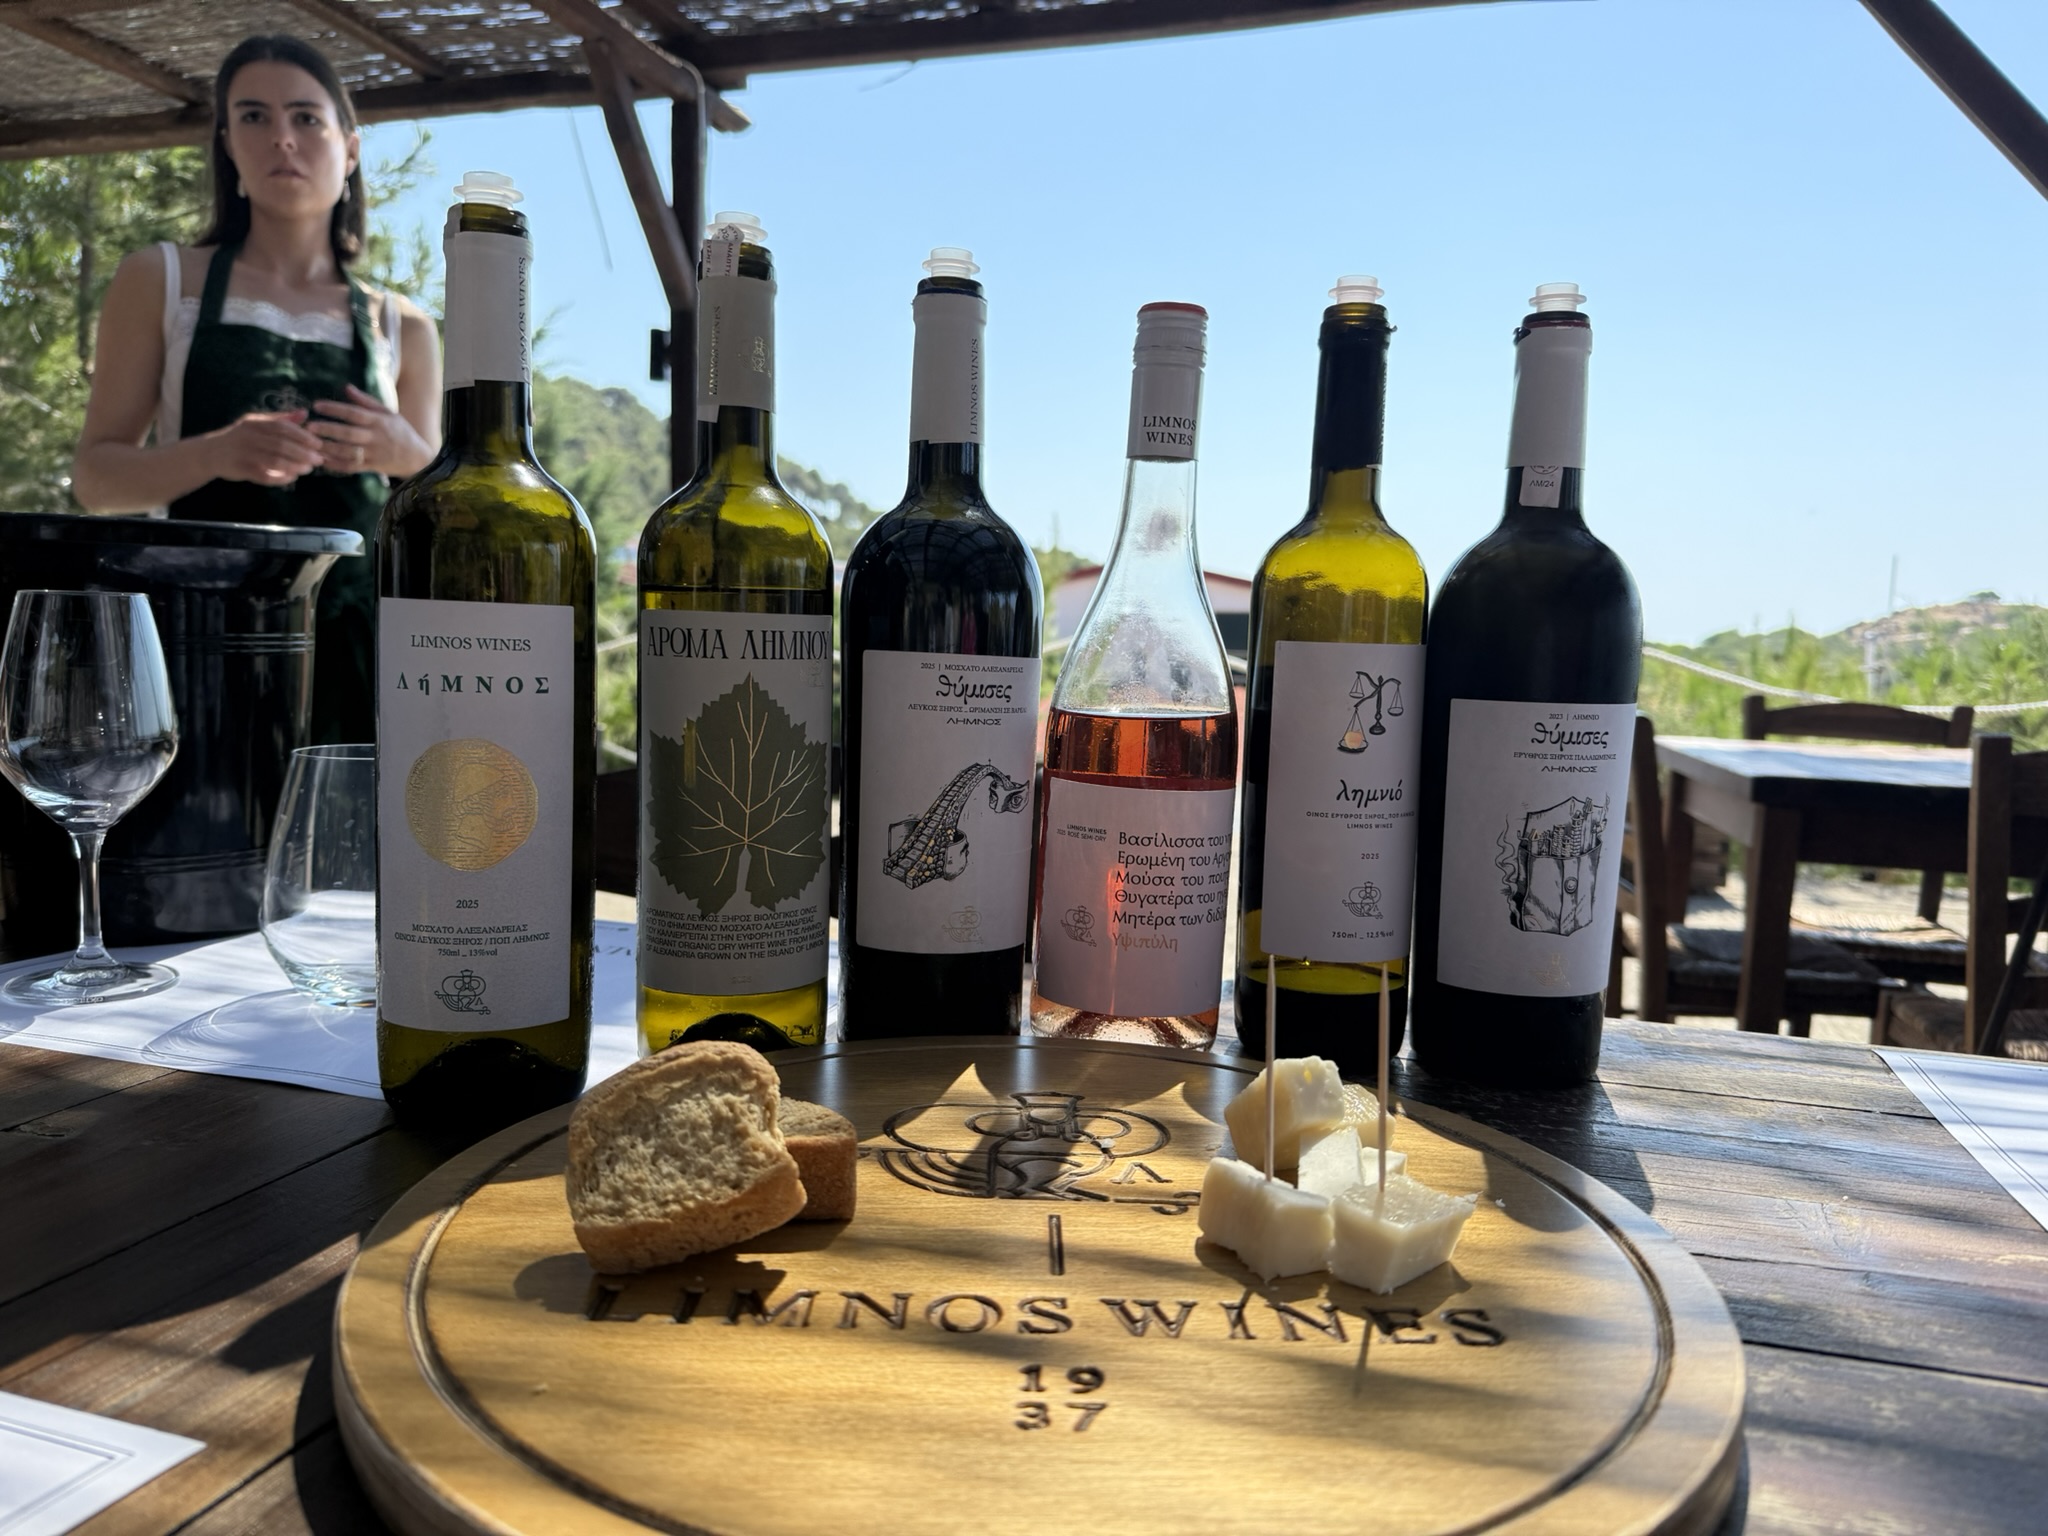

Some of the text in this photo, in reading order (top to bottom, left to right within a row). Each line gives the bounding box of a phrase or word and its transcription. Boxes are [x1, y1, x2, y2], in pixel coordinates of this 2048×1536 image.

[518, 256, 526, 310] WINES
[970, 338, 979, 435] LIMNOS WINES
[1143, 416, 1197, 431] LIMNOS
[1146, 431, 1193, 446] WINES
[411, 635, 531, 651] LIMNOS WINES
[740, 629, 829, 660] ΛΗΜΝΟΥ
[944, 664, 980, 672] ΜΟΣΧΑΤΟ
[908, 703, 938, 712] ΛΕΥΚΟΣ
[939, 705, 963, 713] ΞΗΡΟΣ
[946, 717, 1002, 726] ΛΗΜΝΟΣ
[1513, 752, 1549, 760] ΕΡΥΘΡΟΣ
[1541, 765, 1598, 773] ΛΗΜΝΟΣ
[1336, 779, 1403, 808] λημνιό
[1331, 812, 1363, 820] ΕΡΥΘΡΟΣ
[1066, 824, 1107, 835] LIMNOS WINES
[1119, 831, 1205, 848] Βασίλισσα
[1207, 835, 1224, 847] του
[1117, 851, 1185, 871] Ερωμένη
[1188, 855, 1210, 866] του
[1115, 870, 1175, 887] Μούσα
[1180, 875, 1204, 886] του
[456, 900, 479, 909] 2025
[1114, 889, 1194, 909] Θυγατέρα
[1196, 893, 1215, 905] του
[686, 913, 720, 923] ΛΕΥΚΟΣ
[721, 914, 752, 923] ΞΗΡΟΣ
[754, 908, 799, 922] ΒΙΟΛΟΓΙΚΟΣ
[1112, 911, 1176, 930] Μητέρα
[1179, 913, 1204, 926] των
[412, 924, 528, 934] ΜΟΣΧΑΤΟ ΑΛΕΞΑΝΔΡΕΙΑΣ
[658, 919, 667, 927] ΤΟ
[667, 920, 718, 932] ΦΗΜΙΣΜΕΝΟ
[719, 923, 763, 932] ΜΟΣΧΑΤΟ
[394, 932, 416, 943] ΟΙΝΟΣ
[417, 934, 451, 945] ΛΕΥΚΟΣ
[452, 937, 483, 946] ΞΗΡΟΣ
[489, 936, 511, 945] ΠΟΠ
[512, 932, 550, 944] ΛΗΜΝΟΣ
[710, 933, 734, 942] ΣΤΗΝ
[736, 932, 773, 942] ΕΥΦΟΡΗ
[774, 930, 785, 938] ΓΗ
[786, 928, 800, 937] ΤΗΣ
[1112, 932, 1178, 952] Υψιπύλη
[1332, 931, 1358, 939] 750ml
[678, 941, 716, 951] ORGANIC
[718, 942, 737, 951] DRY
[738, 941, 766, 950] WHITE
[767, 939, 787, 948] WINE
[789, 935, 808, 946] FROM
[438, 949, 460, 957] 750ml
[469, 949, 498, 957] 13%vol
[653, 946, 696, 959] ALEXANDRIA
[697, 951, 731, 960] GROWN
[733, 952, 747, 960] ON
[749, 950, 766, 959] THE
[767, 946, 795, 958] ISLAND
[796, 943, 805, 953] OF
[584, 1285, 1506, 1347] LIMNOS WINES
[1019, 1363, 1105, 1393] 19
[1014, 1401, 1107, 1432] 37
